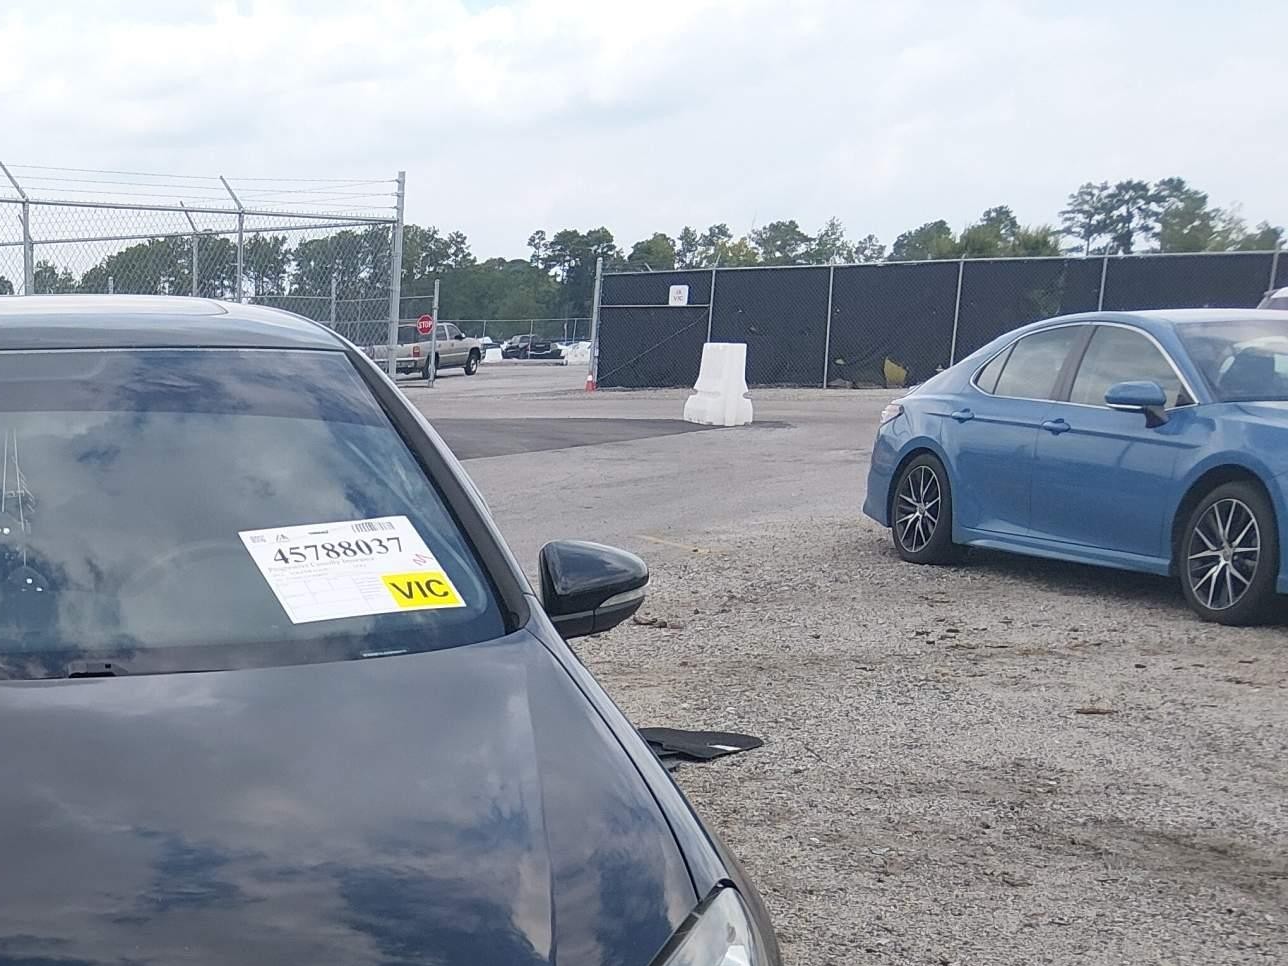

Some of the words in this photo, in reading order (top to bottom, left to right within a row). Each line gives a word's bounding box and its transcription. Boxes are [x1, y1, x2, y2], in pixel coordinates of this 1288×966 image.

[419, 320, 433, 329] STOP
[273, 536, 402, 564] 45788037
[389, 579, 449, 600] VIC
